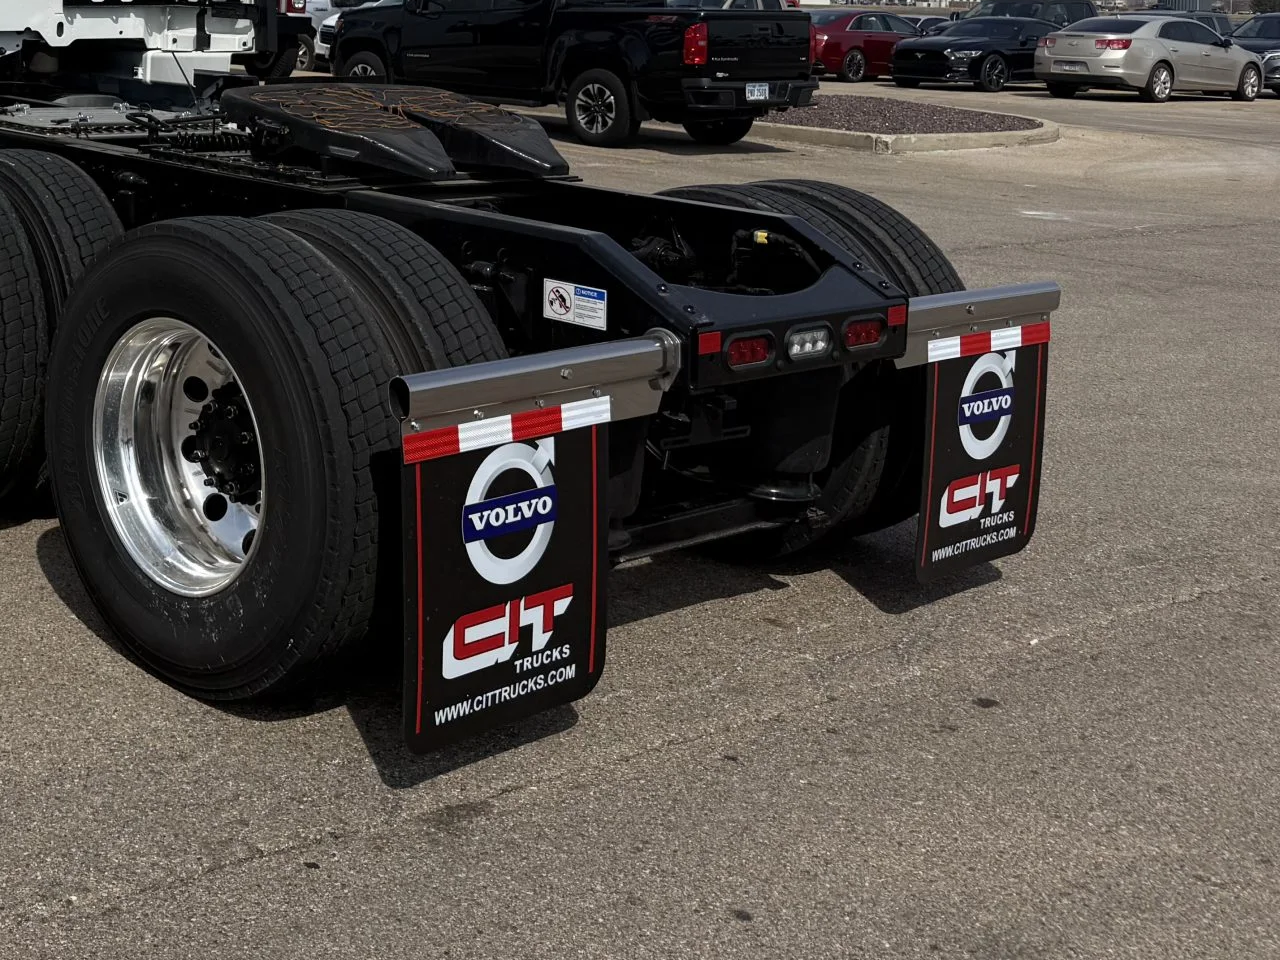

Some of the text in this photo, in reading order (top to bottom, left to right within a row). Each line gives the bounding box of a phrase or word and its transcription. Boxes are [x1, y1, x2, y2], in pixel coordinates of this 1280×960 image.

[961, 394, 1012, 417] VOLVO
[468, 495, 553, 531] VOLVO
[939, 464, 1020, 528] CIT
[979, 510, 1015, 529] TRUCKS
[931, 526, 1017, 563] WWW.CITTRUCKS.COM
[442, 583, 574, 679] CIT
[513, 644, 571, 674] TRUCKS
[434, 664, 577, 726] WWW.CITTRUCKS.COM
